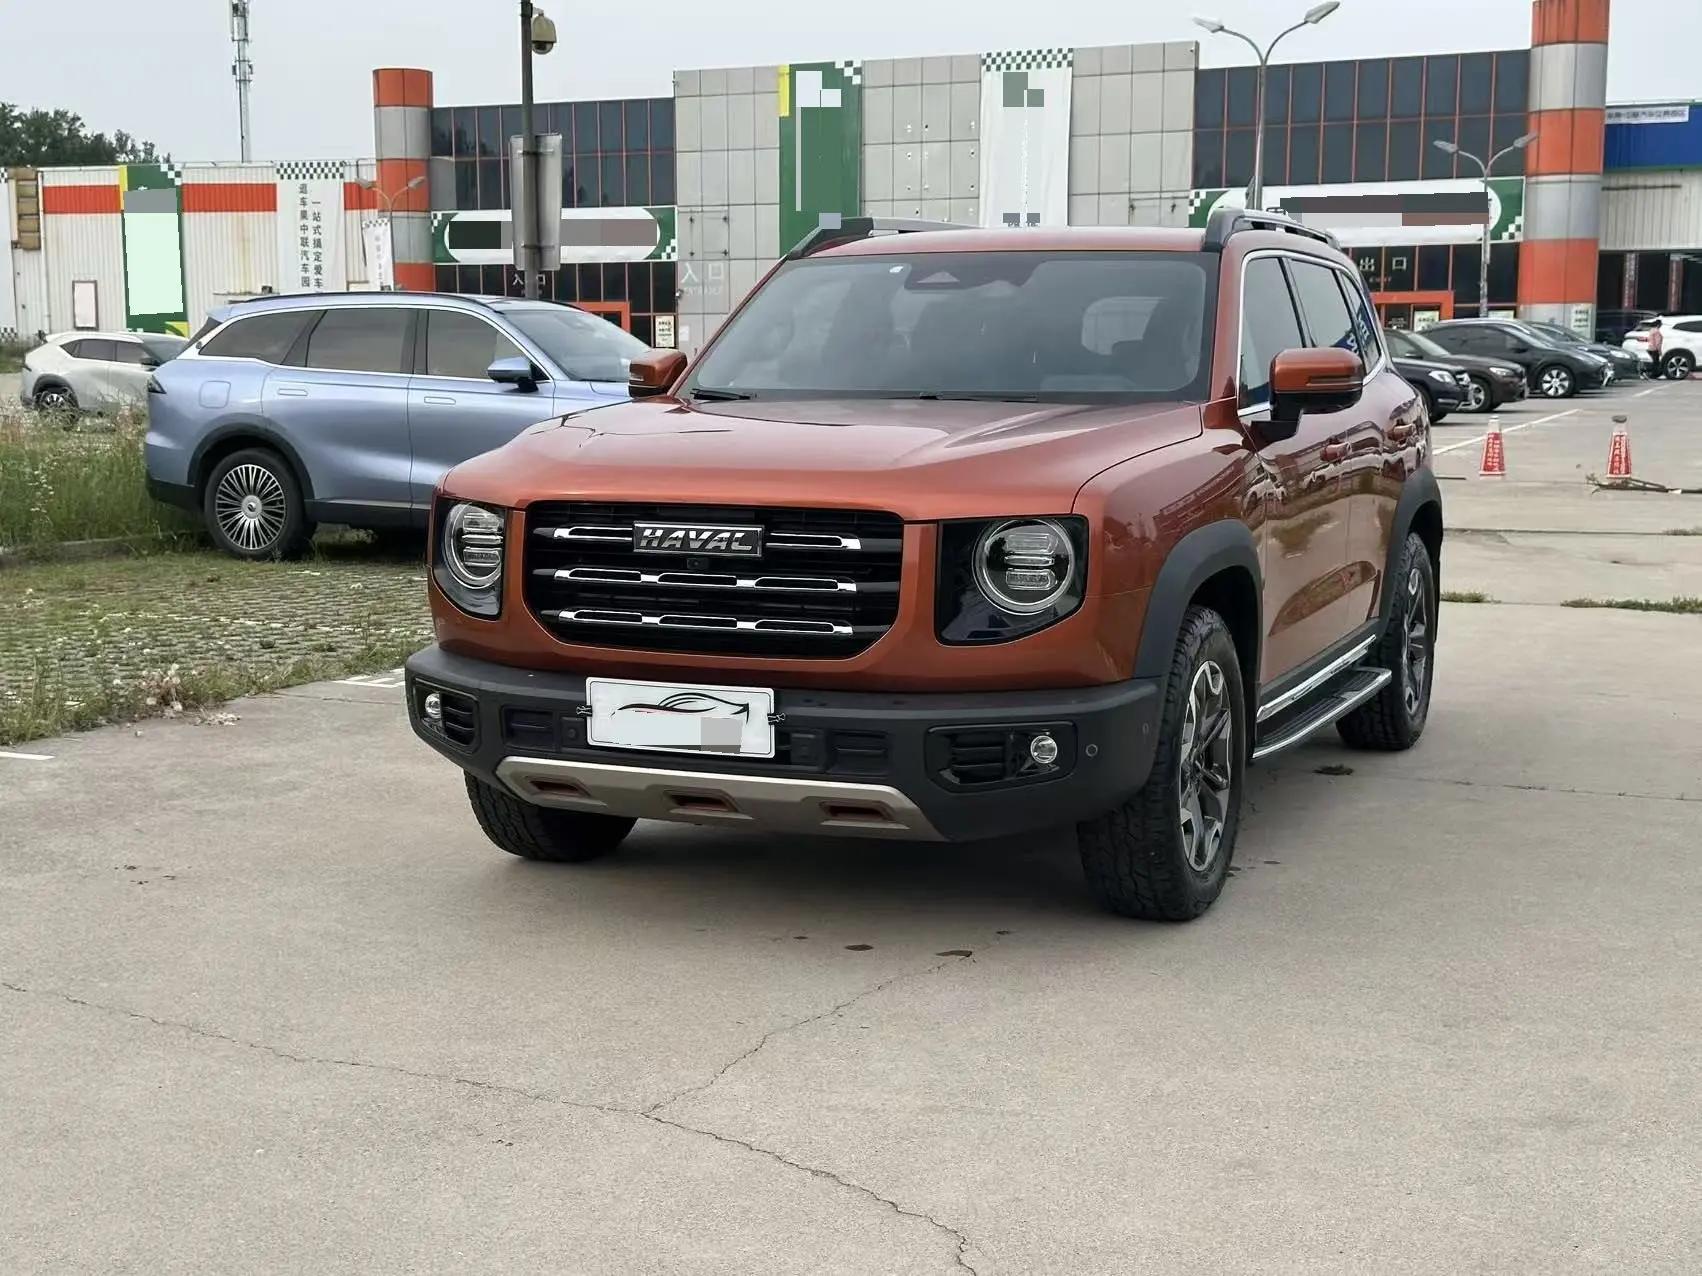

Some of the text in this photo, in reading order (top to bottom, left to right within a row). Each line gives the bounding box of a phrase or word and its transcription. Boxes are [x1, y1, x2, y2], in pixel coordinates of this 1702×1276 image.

[311, 200, 323, 289] 一站式搞定爱车
[680, 262, 724, 283] 入口
[1359, 256, 1407, 271] 出口
[640, 528, 752, 550] HAVAL
